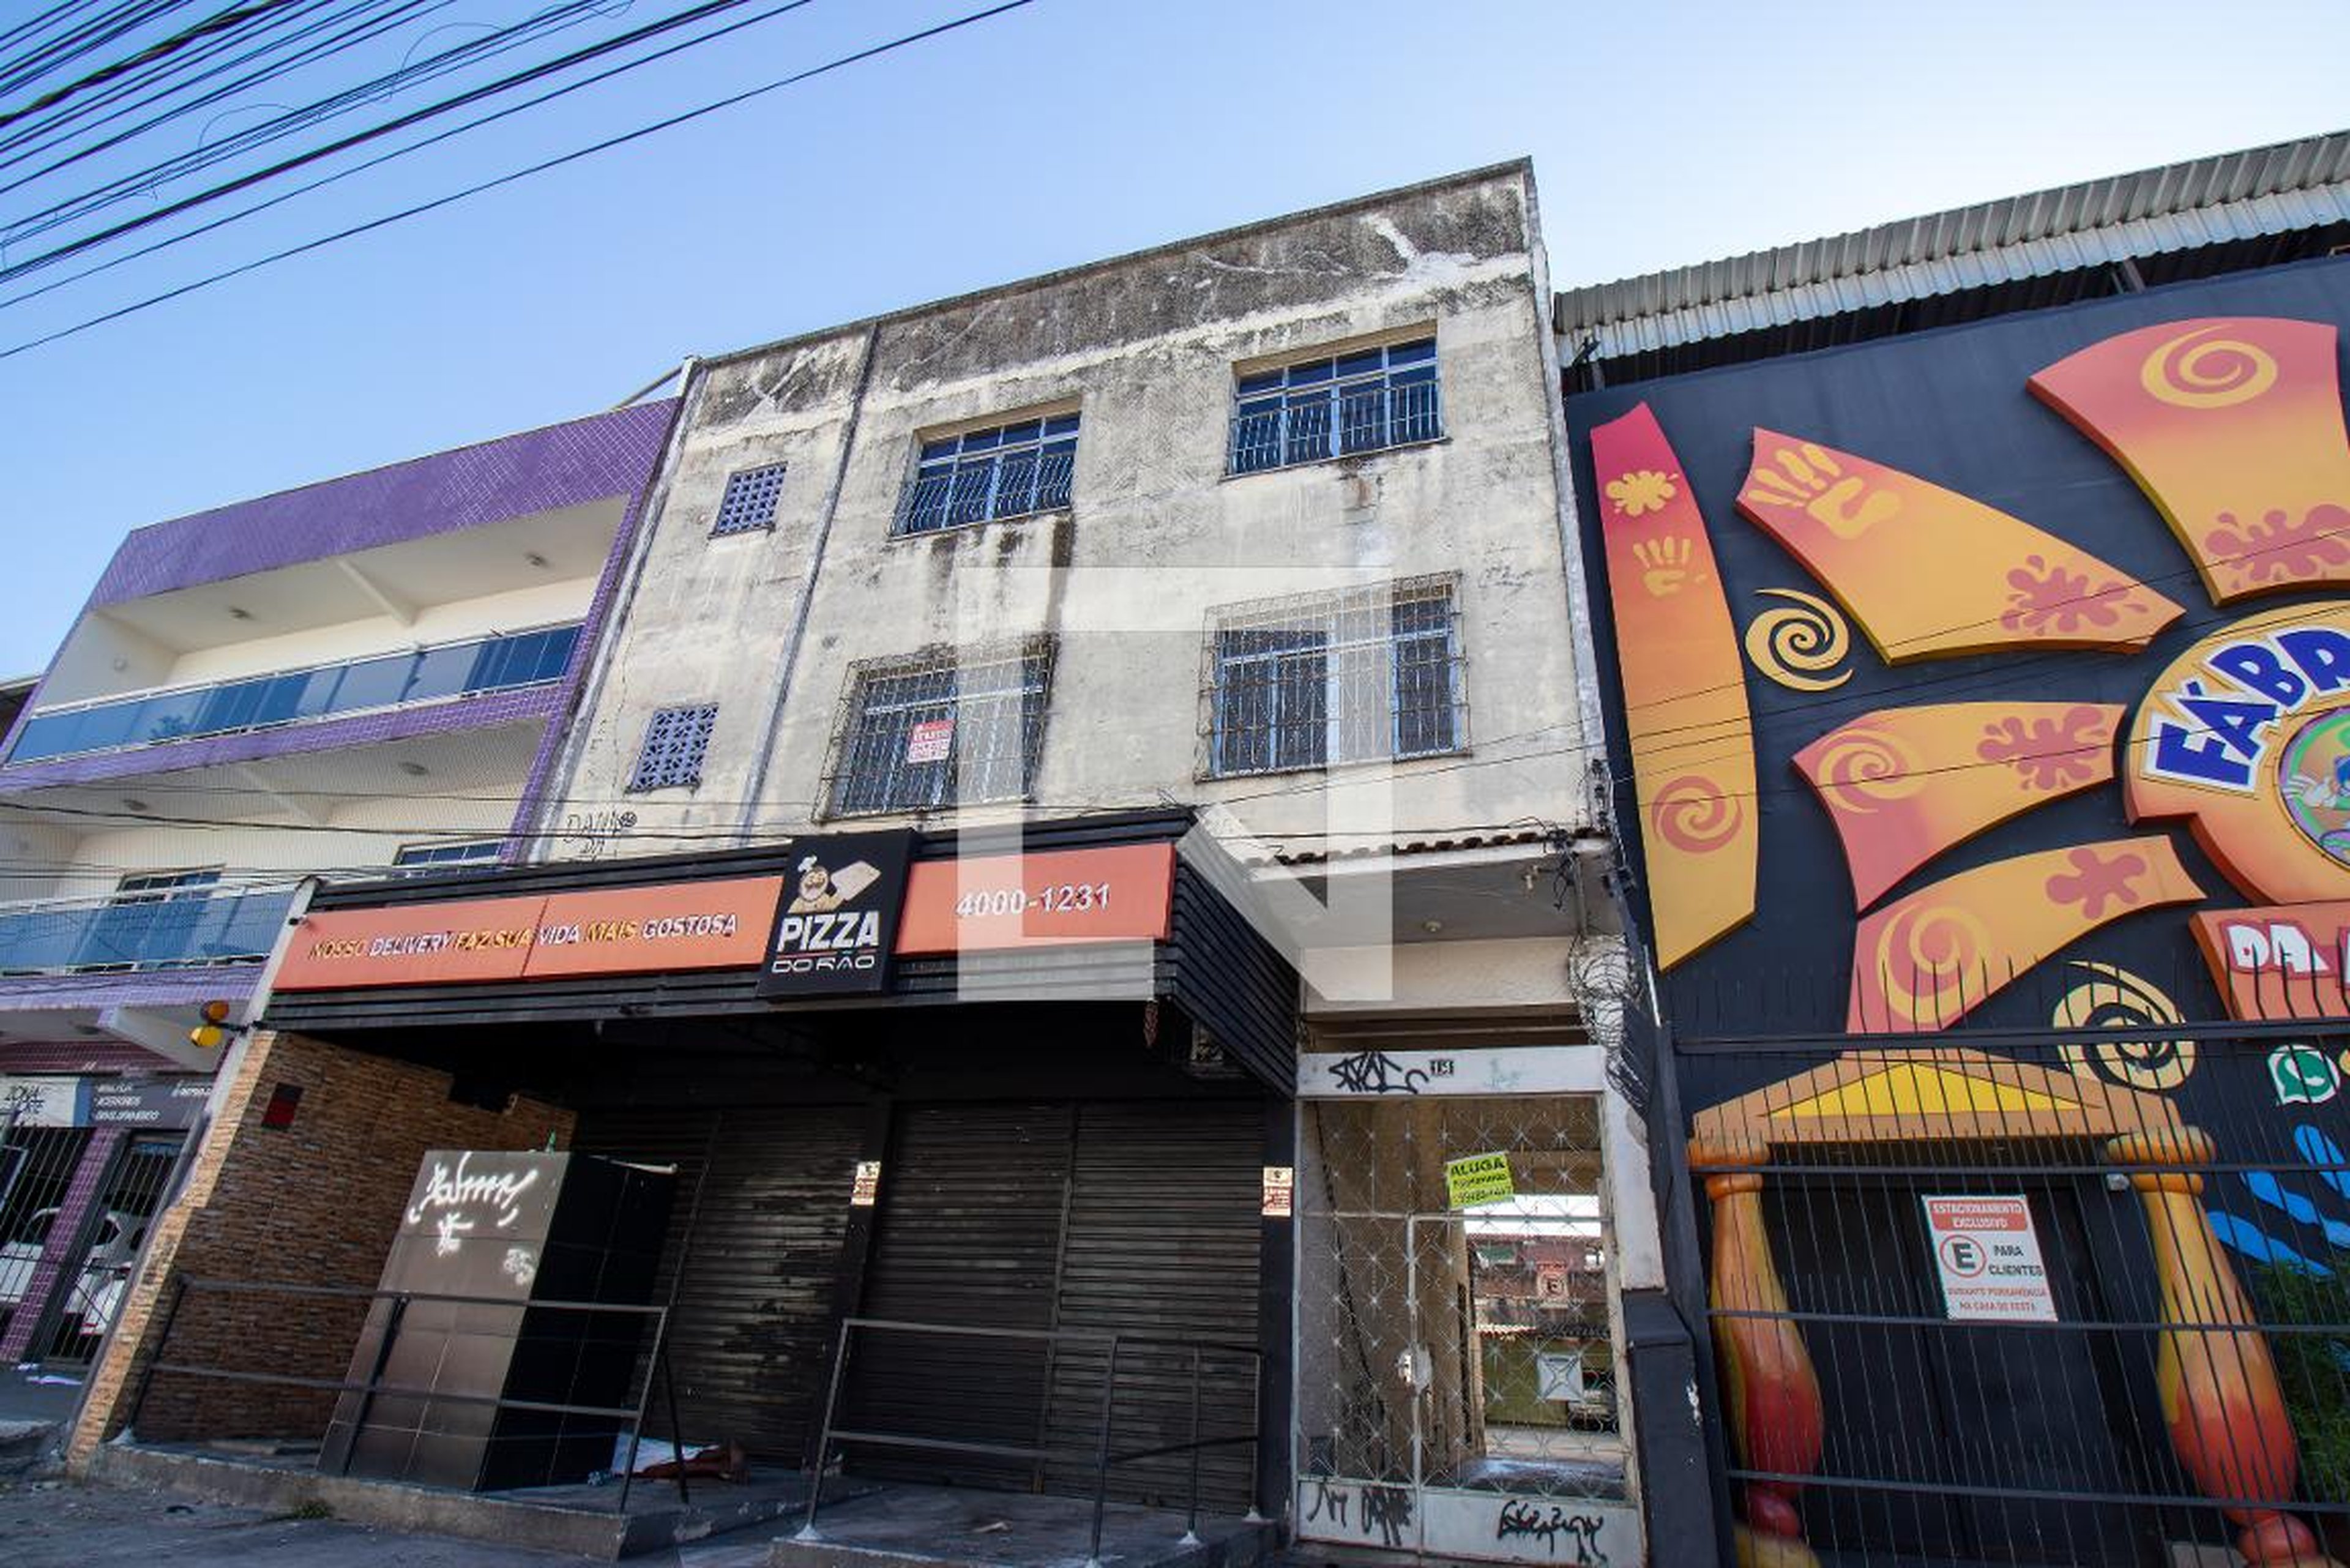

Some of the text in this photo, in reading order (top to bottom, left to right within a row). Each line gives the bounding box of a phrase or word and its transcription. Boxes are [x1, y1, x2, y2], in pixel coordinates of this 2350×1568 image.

[956, 883, 1110, 917] 4000-1231
[308, 913, 737, 959] NOSSO DELIVERY FAZ SUA VIDA MAIS GOSTOSA
[777, 911, 879, 952] PIZZA
[1451, 1157, 1505, 1176] ALUGA
[1930, 1203, 2024, 1214] ESTACIONAMENTO
[1951, 1217, 2008, 1229] EXCLUSIVO
[1952, 1243, 1976, 1269] E
[1993, 1244, 2024, 1256] PARA
[1988, 1264, 2044, 1277] CLIENTES
